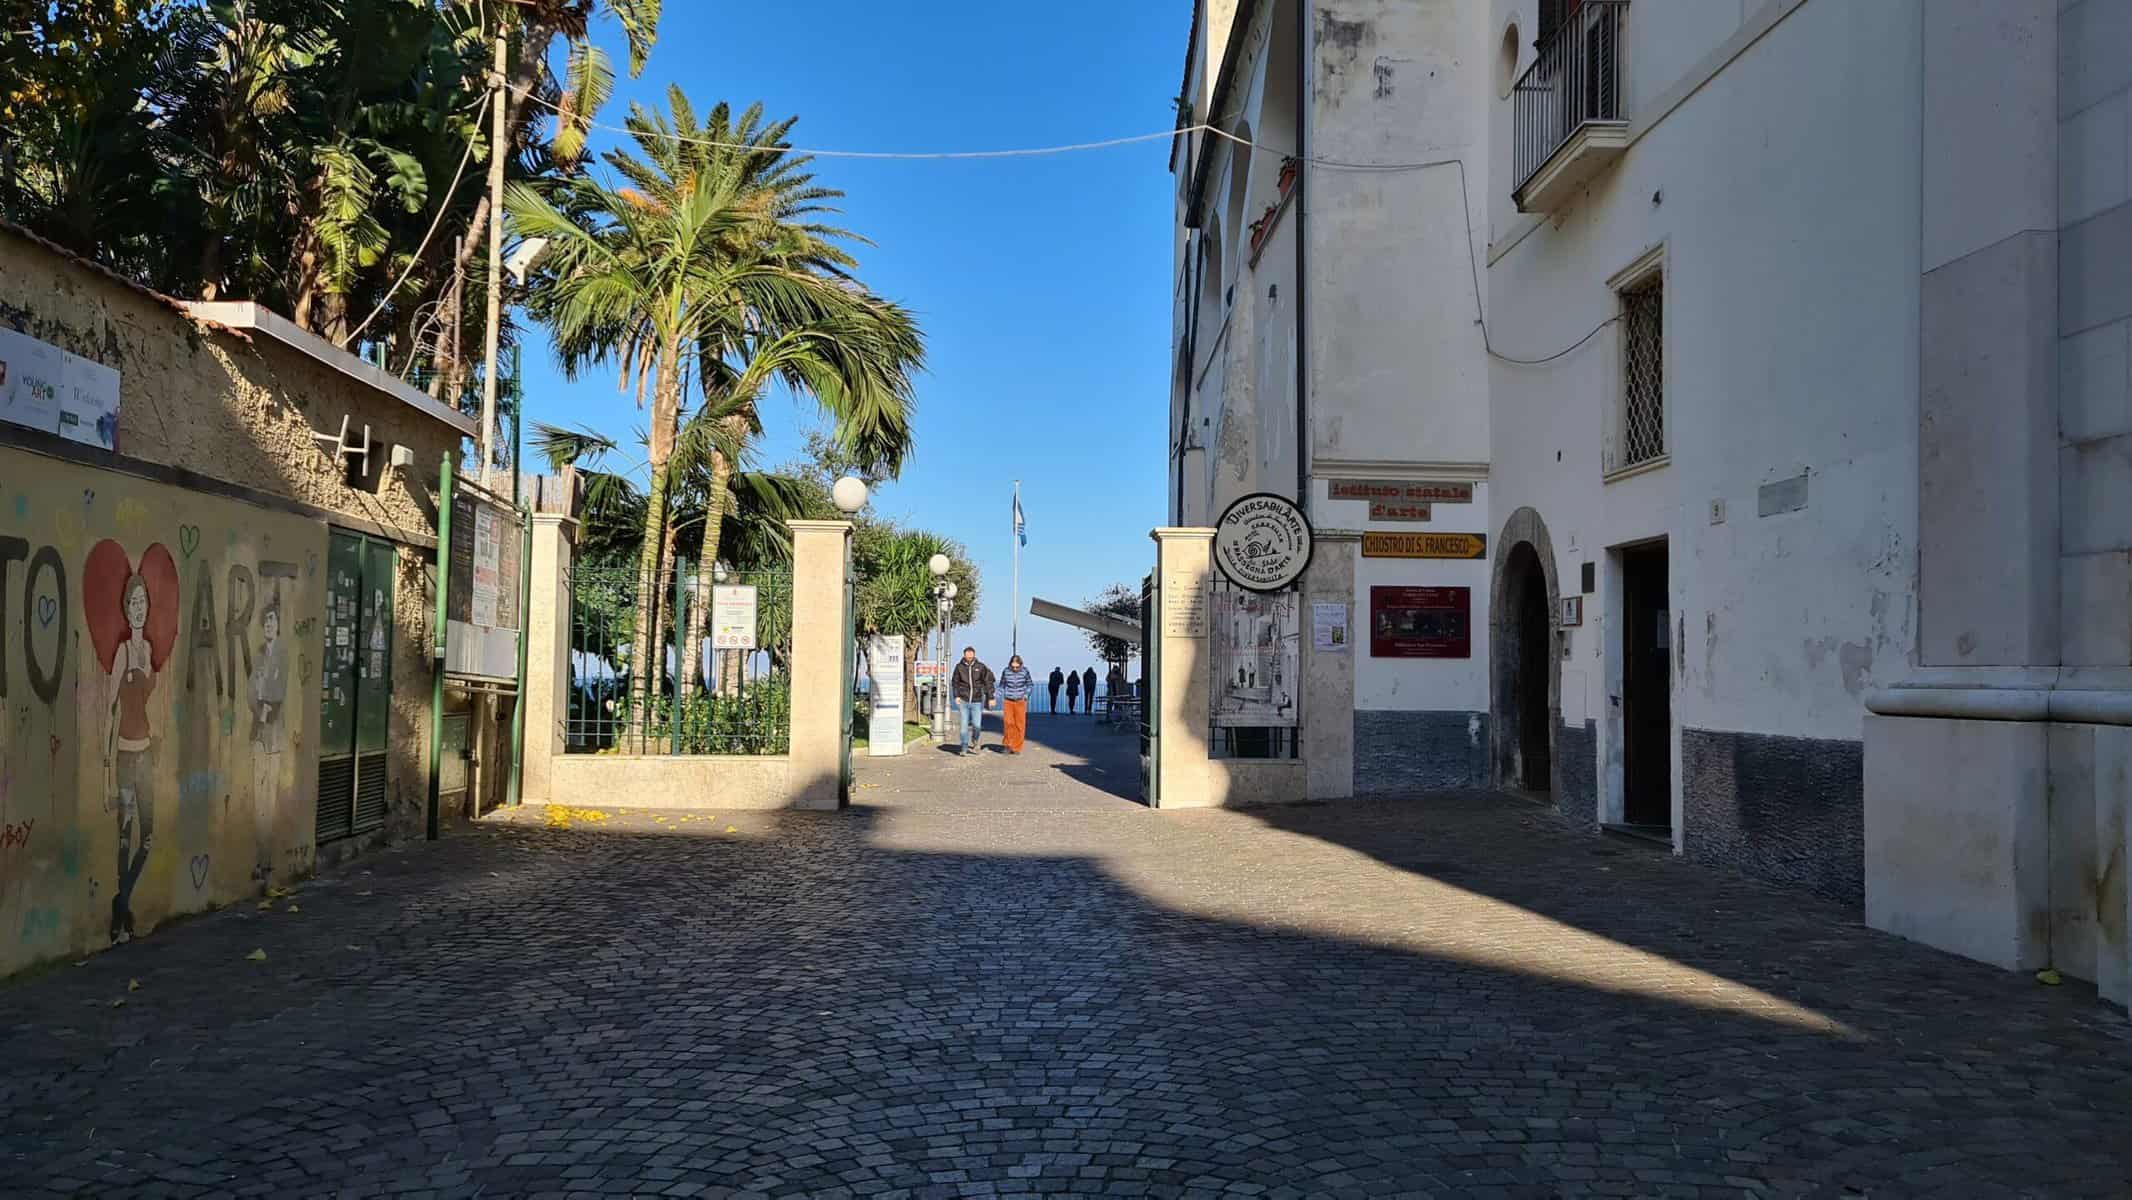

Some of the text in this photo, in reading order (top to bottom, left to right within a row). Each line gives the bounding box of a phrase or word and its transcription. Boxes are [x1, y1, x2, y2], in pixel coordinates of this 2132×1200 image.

[1364, 535, 1469, 554] CHIOSTRO DI S. FRANCESCO
[186, 559, 298, 701] ART
